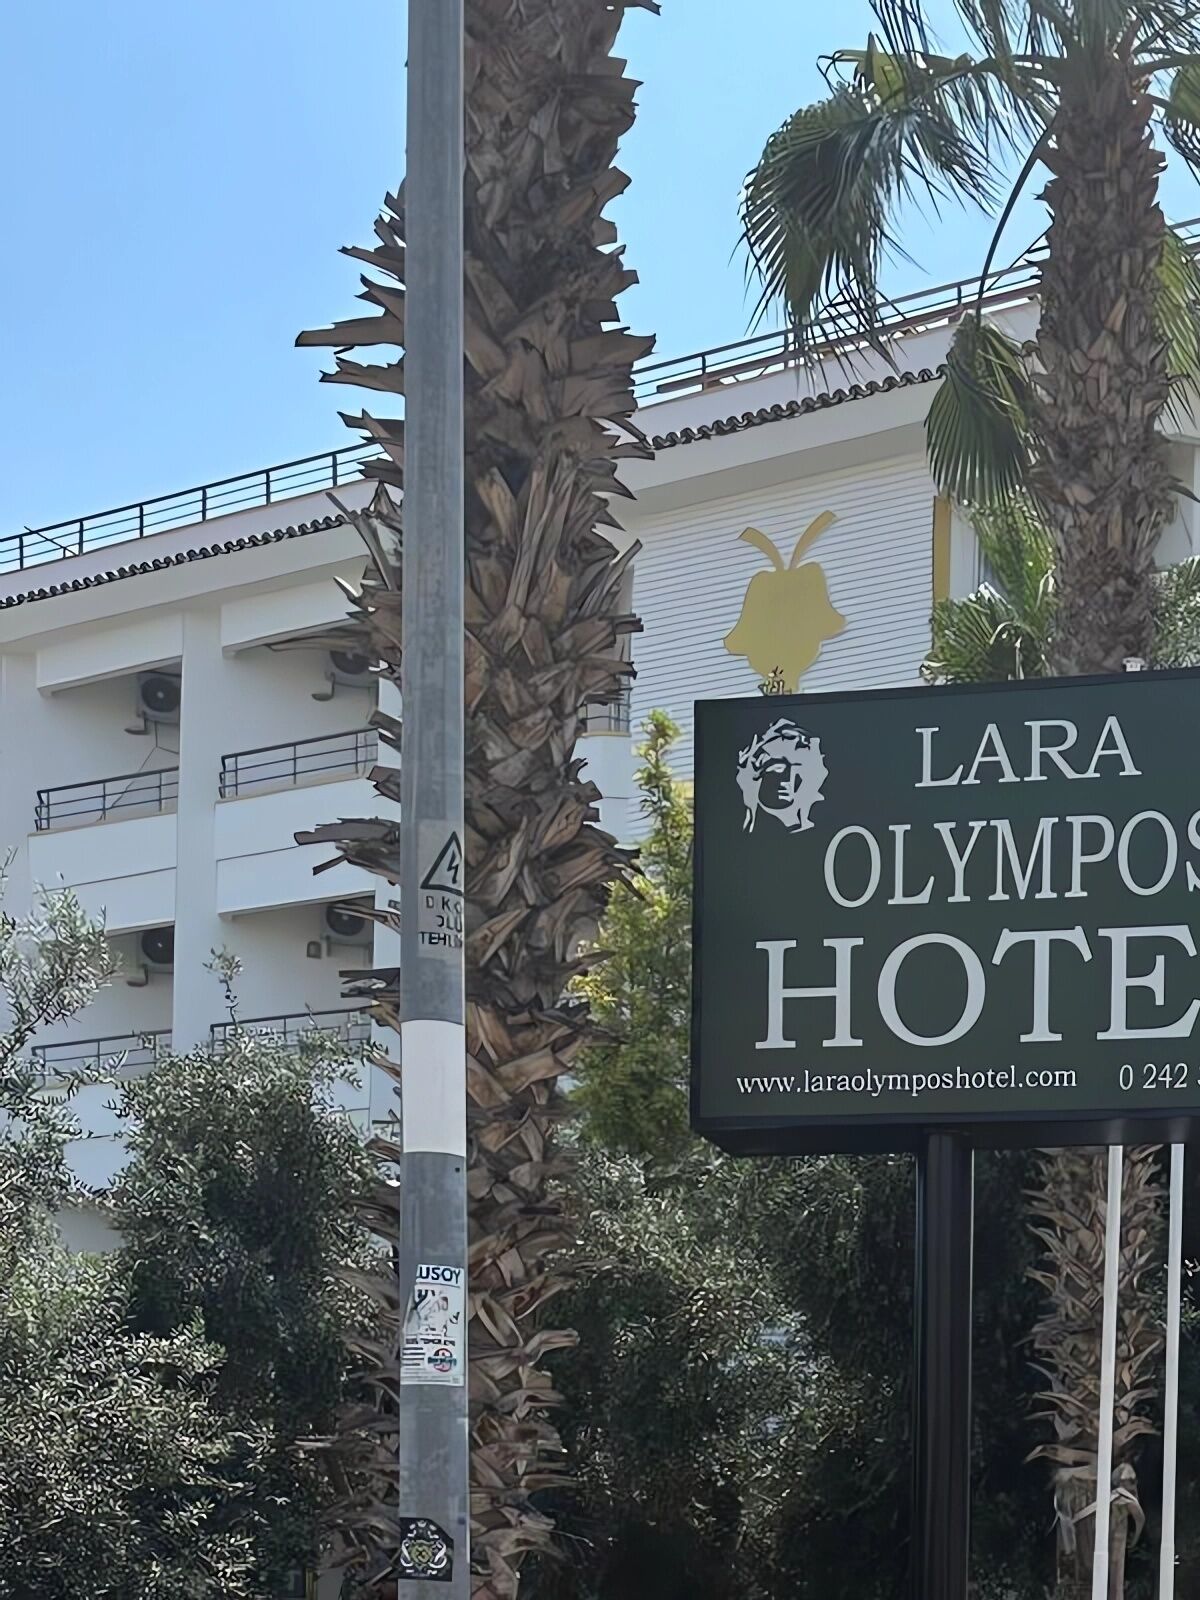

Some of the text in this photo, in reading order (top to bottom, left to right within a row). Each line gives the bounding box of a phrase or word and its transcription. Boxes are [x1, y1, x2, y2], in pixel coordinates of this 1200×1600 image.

[914, 715, 1142, 789] LARA
[736, 1065, 1077, 1097] www.laraolymposhotel.com
[1119, 1064, 1134, 1090] 0
[1142, 1062, 1188, 1089] 242
[416, 1266, 461, 1284] USOY
